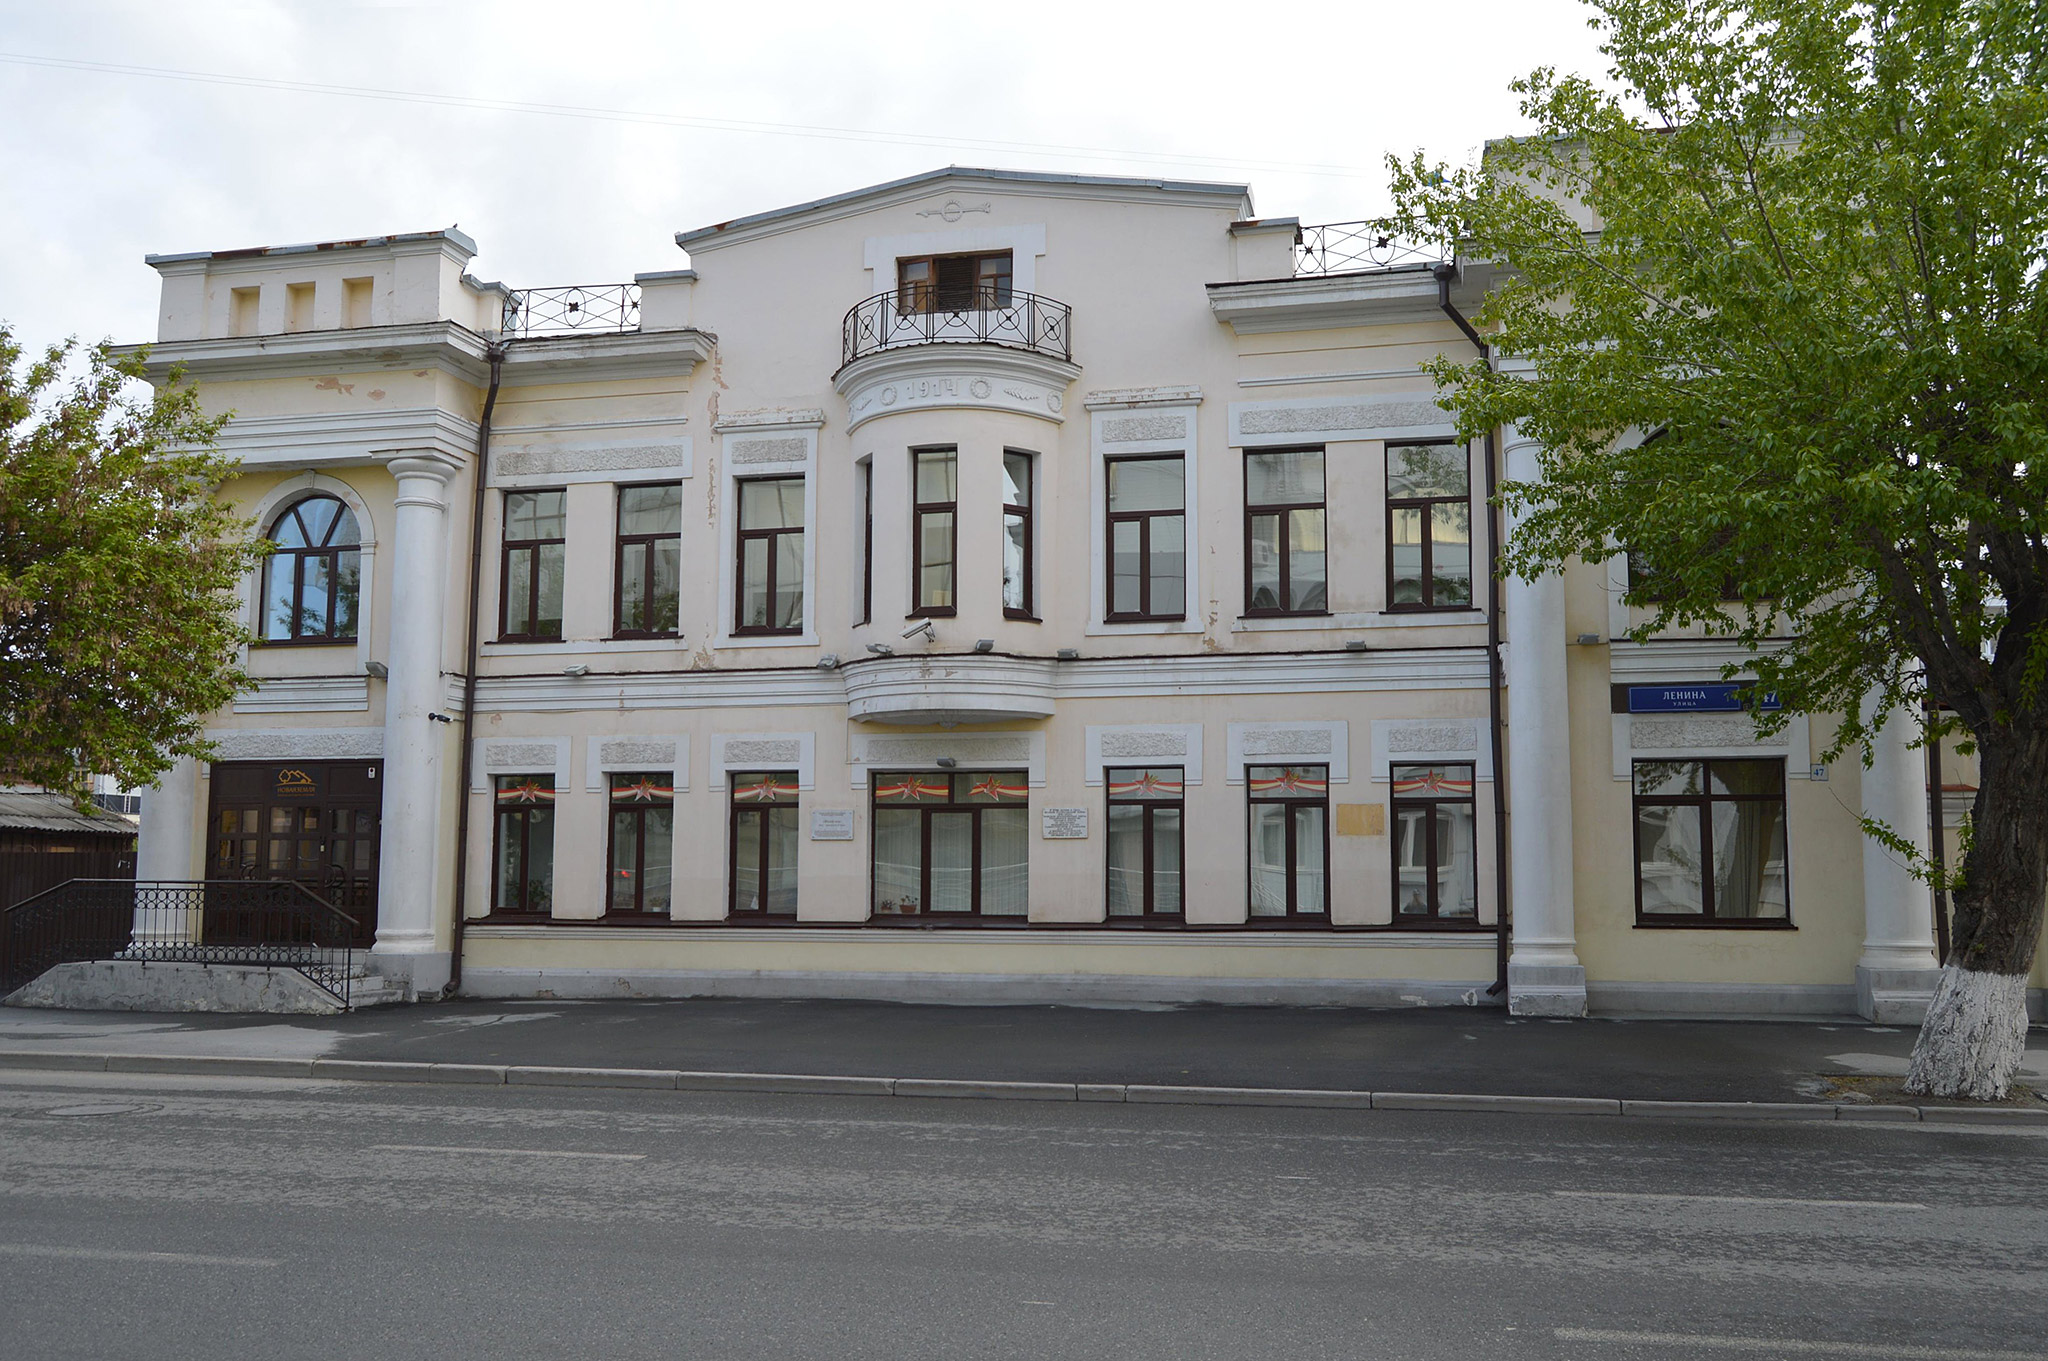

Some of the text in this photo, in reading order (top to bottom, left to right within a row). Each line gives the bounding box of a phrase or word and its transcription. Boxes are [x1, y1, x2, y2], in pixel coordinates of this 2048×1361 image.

[907, 378, 958, 399] 1914
[1663, 690, 1706, 700] ЛЕНИНА
[1813, 768, 1824, 776] 47
